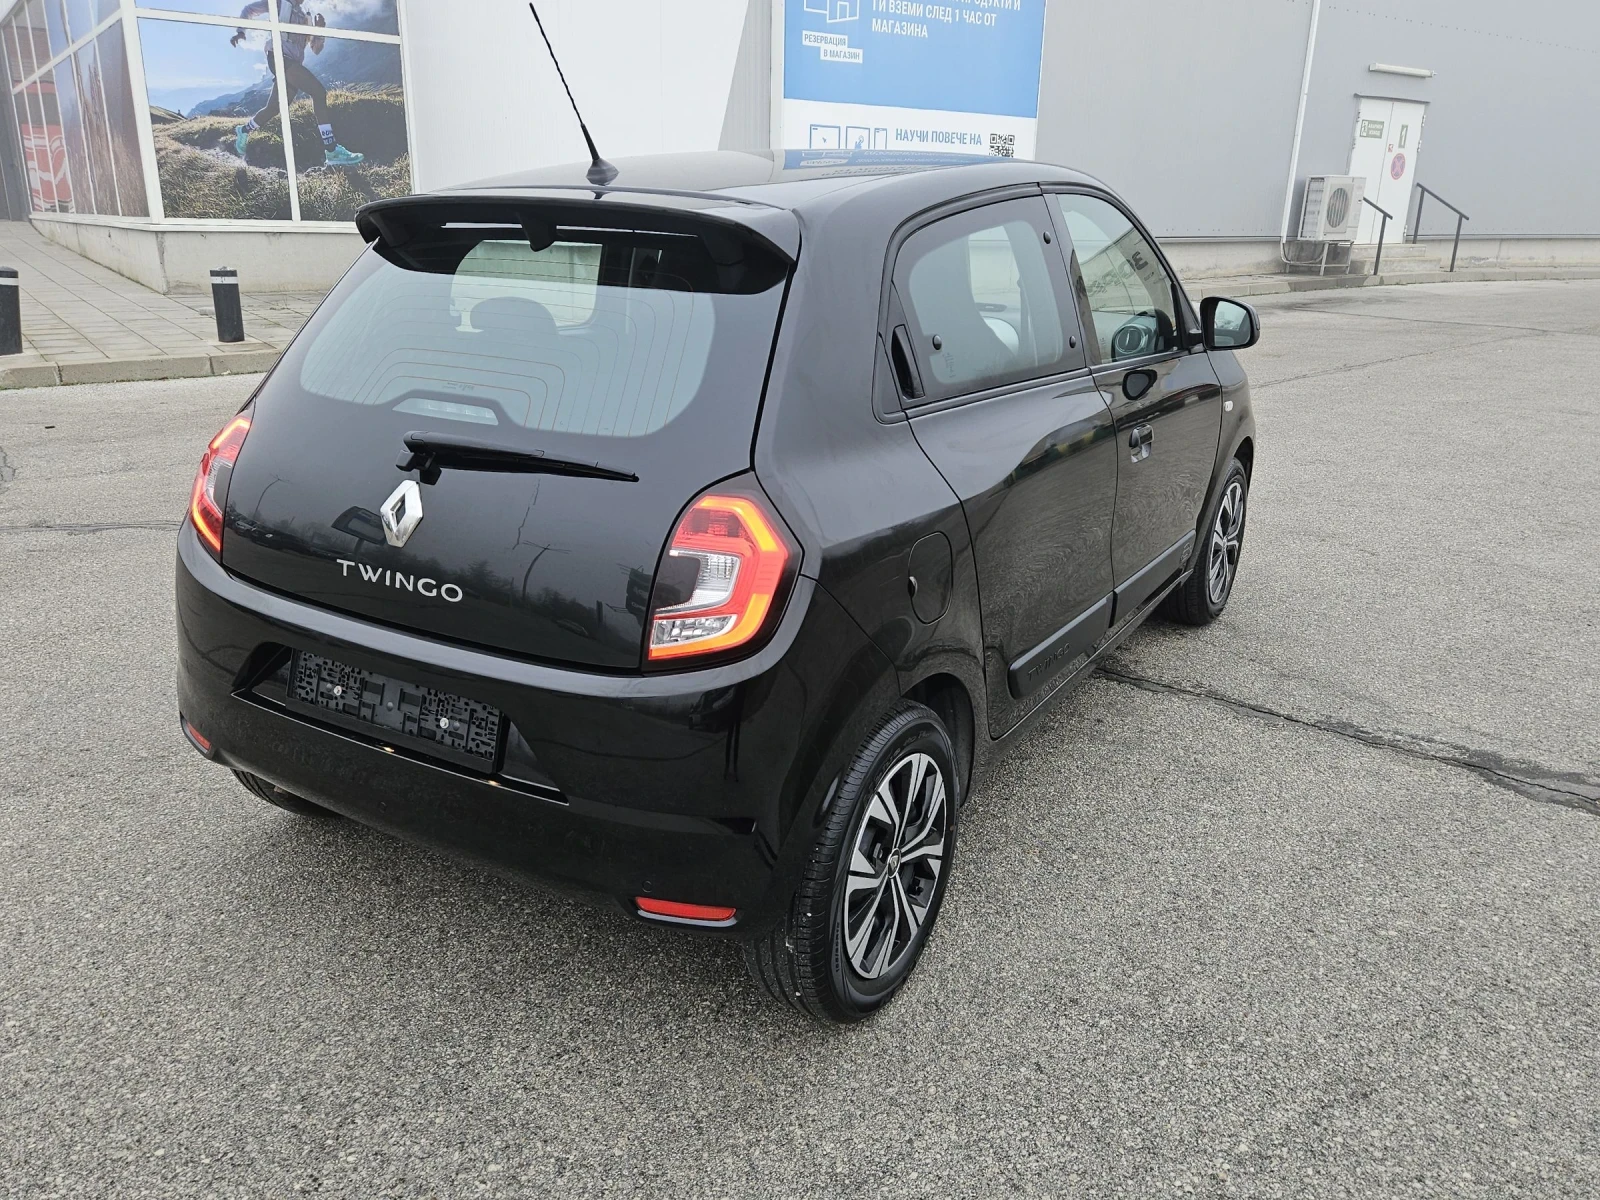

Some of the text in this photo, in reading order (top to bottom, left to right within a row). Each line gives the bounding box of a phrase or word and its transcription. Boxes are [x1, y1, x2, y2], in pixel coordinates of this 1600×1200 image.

[889, 0, 923, 17] ВЗЕМИ
[926, 5, 951, 23] СЛЕД
[955, 9, 960, 22] 1
[963, 10, 982, 25] ЧАС
[984, 13, 997, 27] ОТ
[872, 18, 928, 38] МАГАЗИНА
[804, 33, 846, 47] РЕЗЕРВАЦИЯ
[823, 48, 860, 60] В МАГАЗИН
[895, 128, 982, 146] НАУЧИ ПОВЕЧЕ НА
[336, 558, 463, 603] TWINGO
